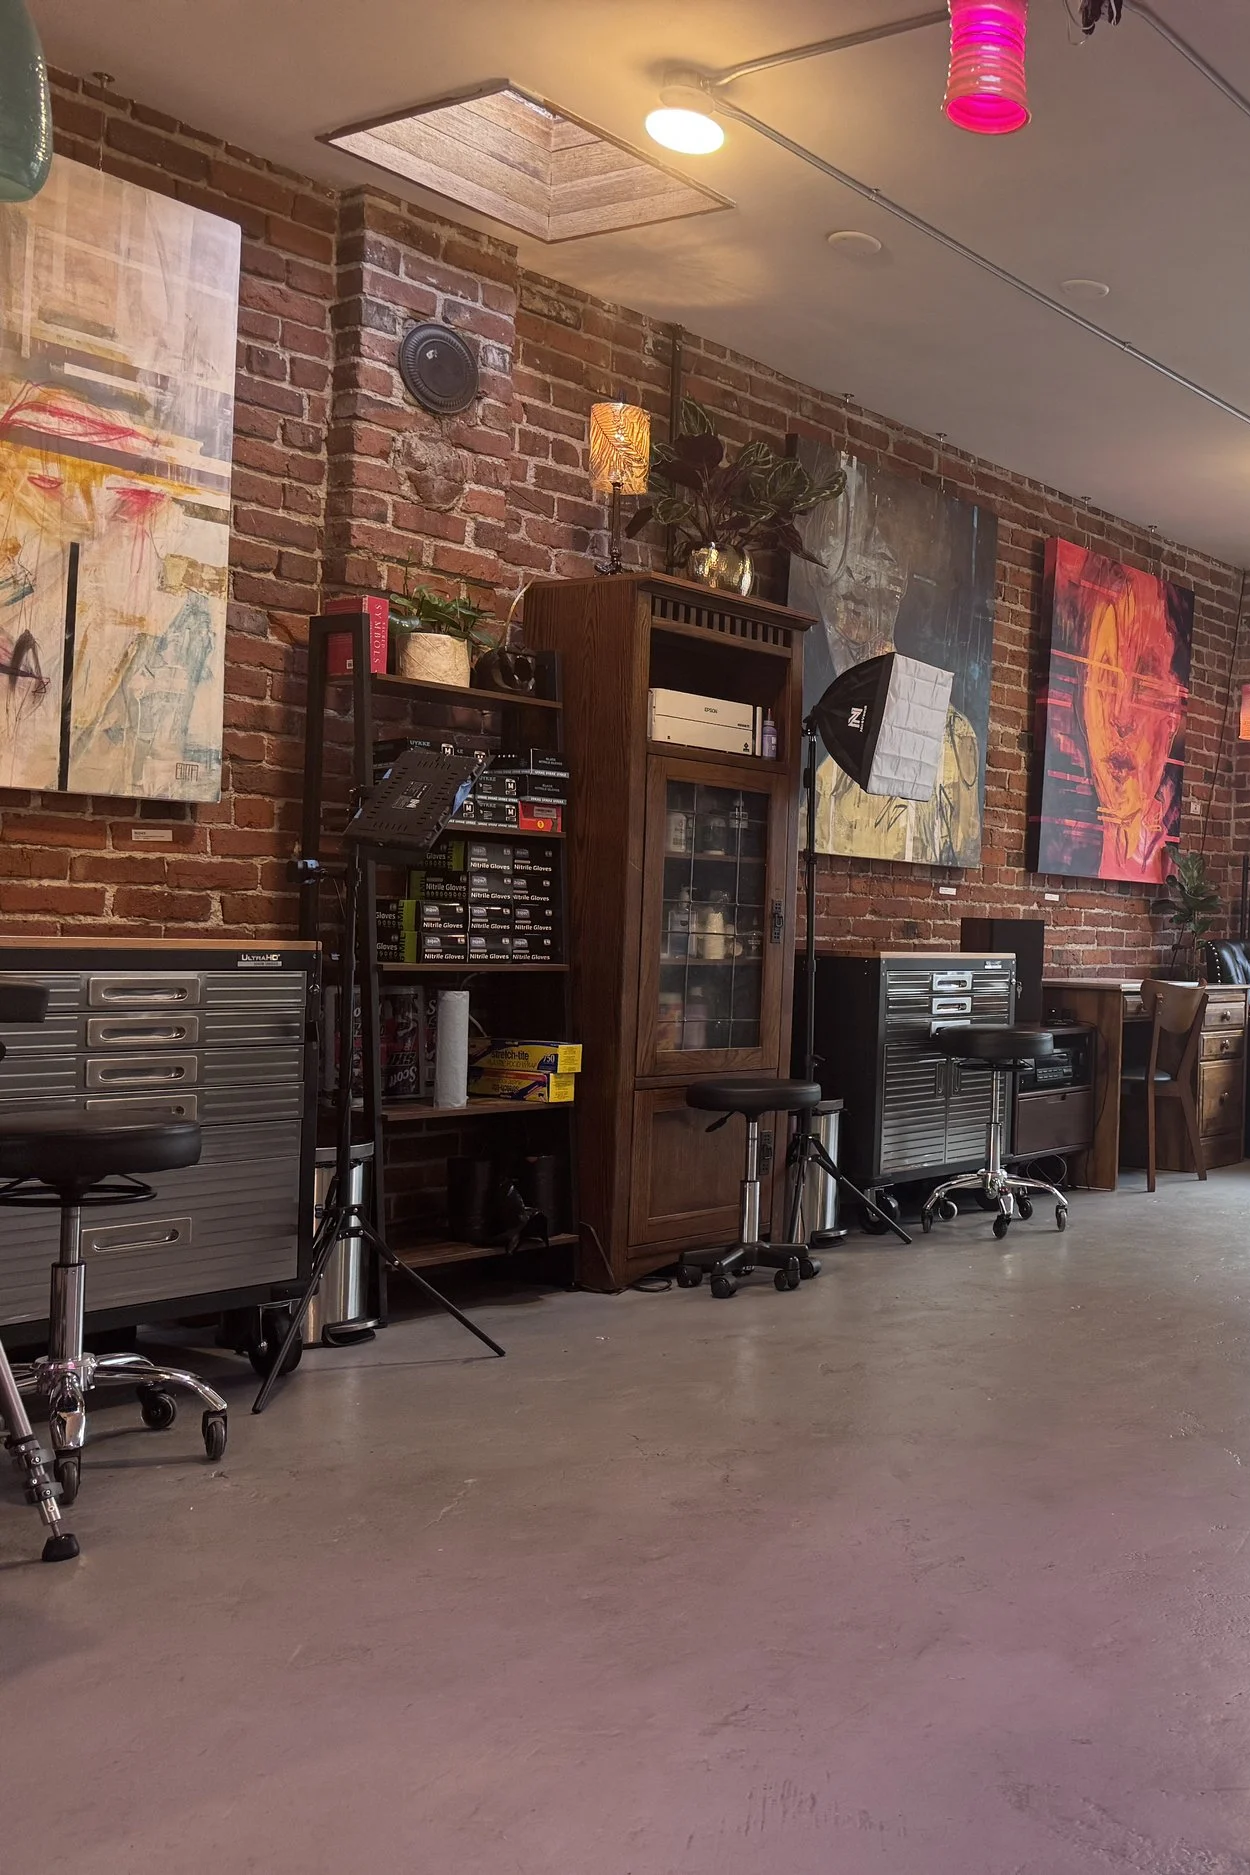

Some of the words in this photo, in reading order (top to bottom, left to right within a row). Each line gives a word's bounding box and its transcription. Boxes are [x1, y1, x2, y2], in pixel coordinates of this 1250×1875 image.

[373, 604, 382, 664] SYMBOLS
[426, 883, 445, 891] Nitrile
[445, 884, 467, 892] Gloves
[388, 1066, 417, 1088] Scott
